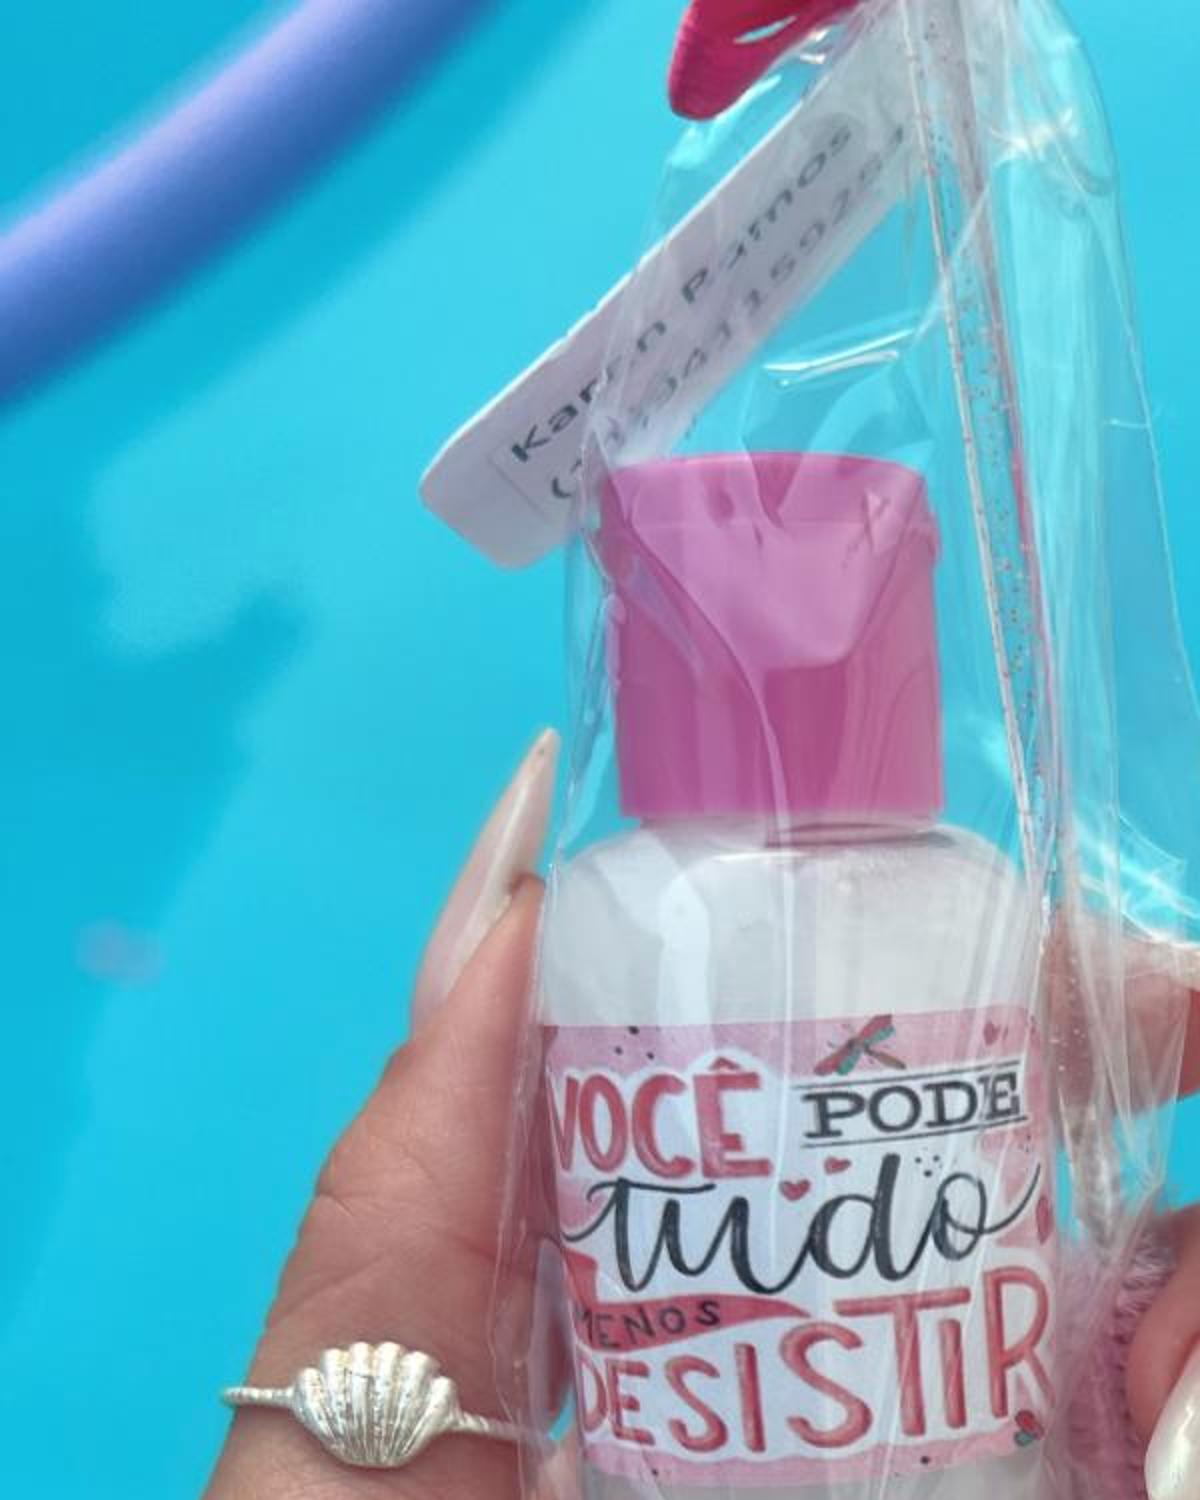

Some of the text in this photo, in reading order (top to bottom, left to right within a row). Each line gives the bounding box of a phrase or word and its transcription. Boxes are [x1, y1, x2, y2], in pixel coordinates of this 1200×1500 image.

[547, 1056, 1021, 1179] VOCÊ PODE
[563, 1153, 1041, 1295] tudo
[574, 1266, 1053, 1453] DESISTIR
